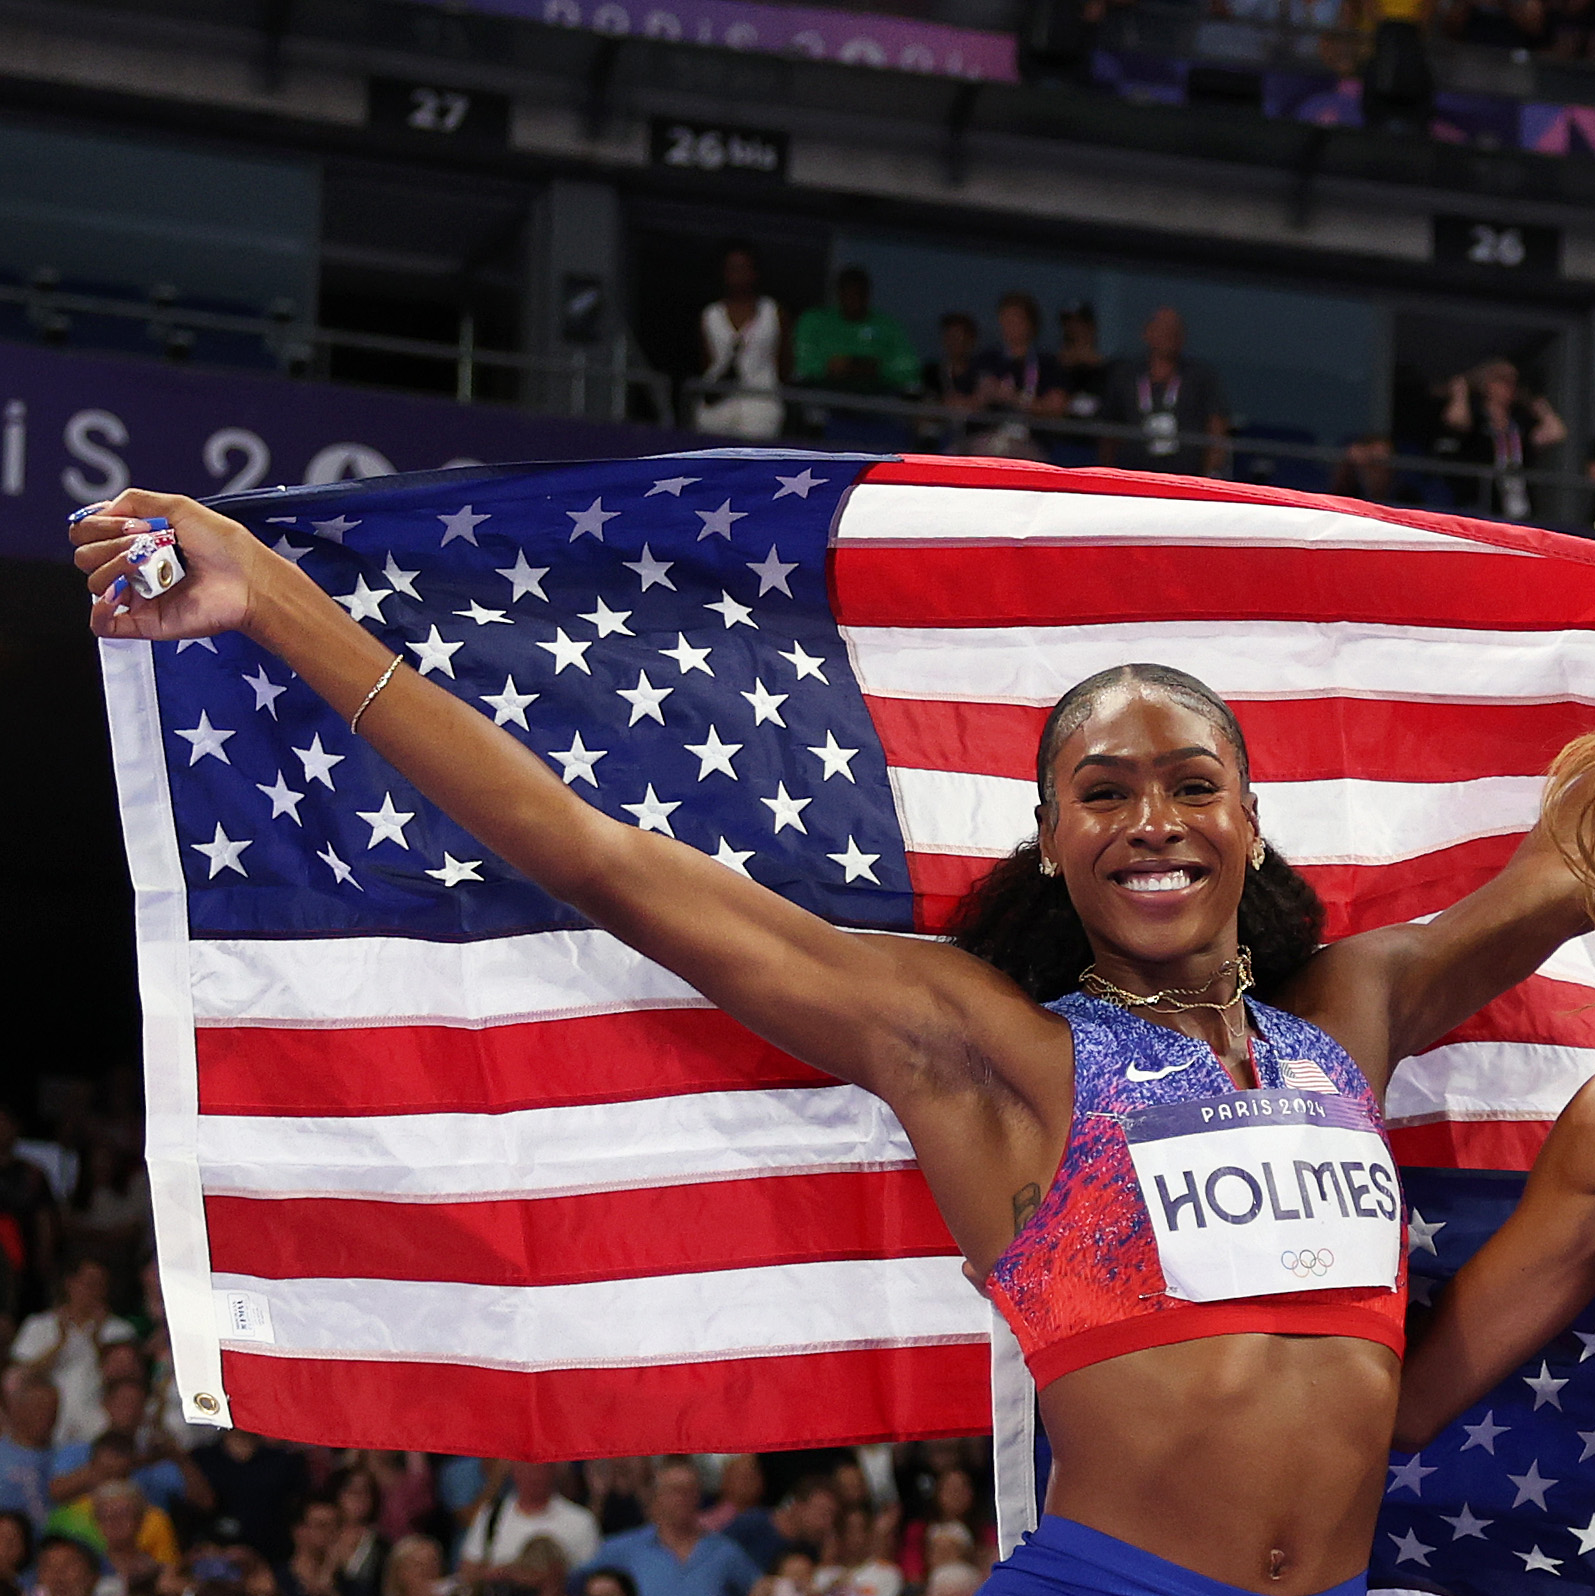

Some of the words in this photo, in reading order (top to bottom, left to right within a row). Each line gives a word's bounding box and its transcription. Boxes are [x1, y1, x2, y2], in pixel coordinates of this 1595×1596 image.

[406, 86, 469, 133] 27
[1468, 224, 1526, 267] 26
[1279, 1097, 1326, 1118] 2024
[1154, 1160, 1398, 1232] HOLMES
